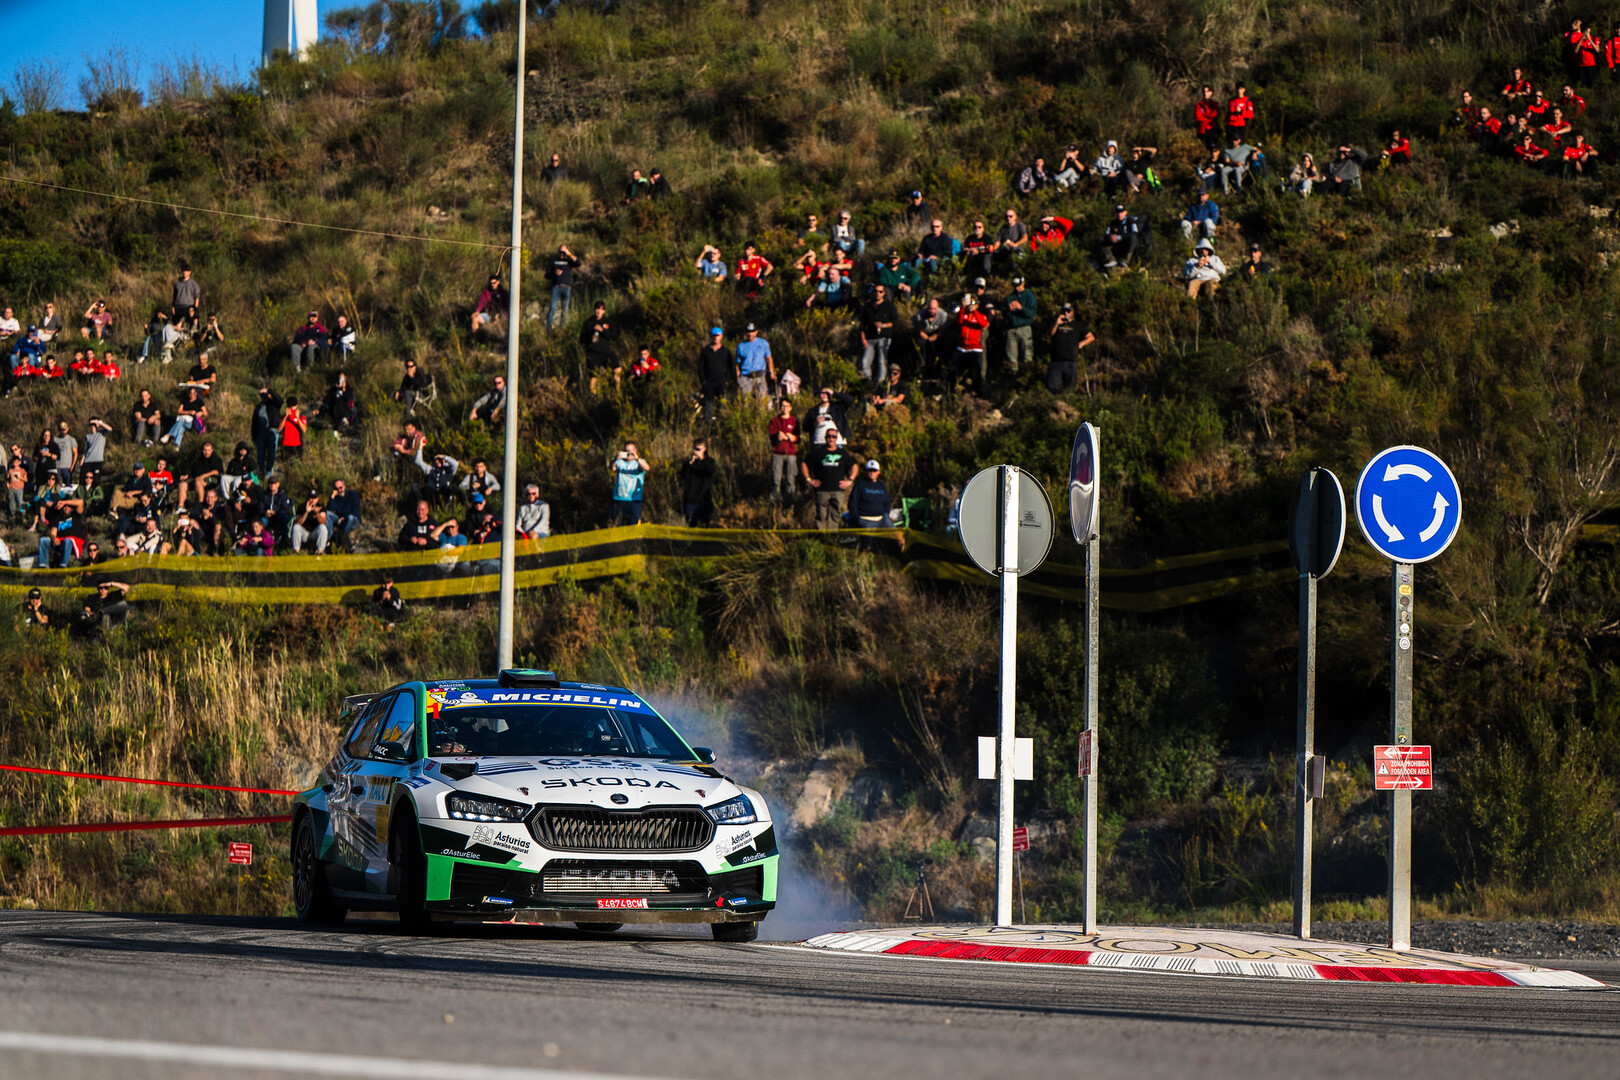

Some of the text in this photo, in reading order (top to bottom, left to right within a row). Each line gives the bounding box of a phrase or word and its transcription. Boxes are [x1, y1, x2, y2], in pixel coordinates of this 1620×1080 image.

[491, 693, 641, 709] MICHELIN
[427, 702, 440, 719] 1
[494, 830, 531, 849] Asturias
[730, 829, 752, 846] Asturias
[449, 849, 481, 860] AsturElec
